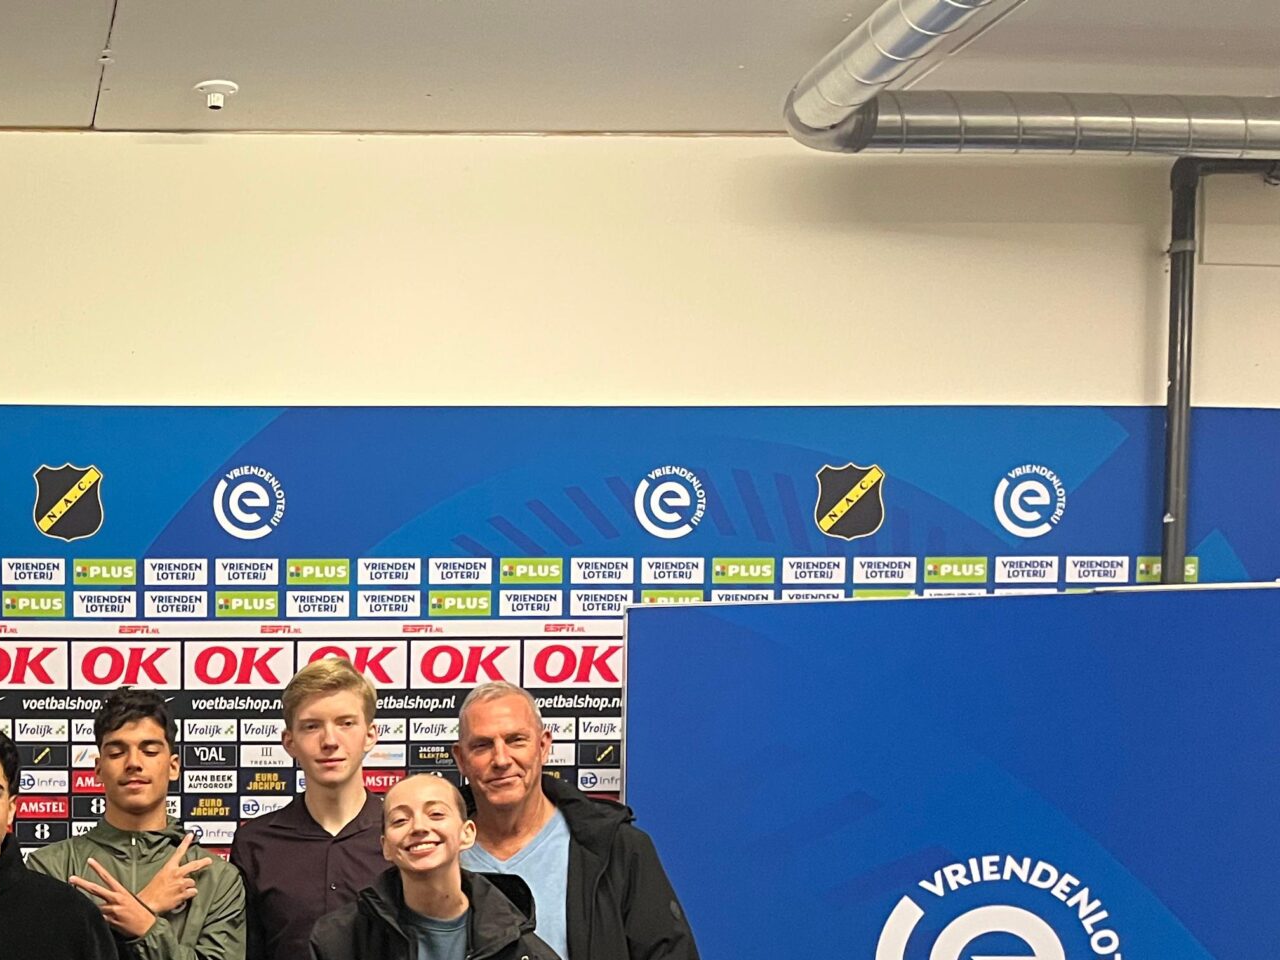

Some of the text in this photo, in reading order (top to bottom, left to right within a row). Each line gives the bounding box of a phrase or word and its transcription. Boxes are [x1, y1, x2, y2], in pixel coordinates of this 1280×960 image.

[225, 465, 286, 527] VRIENDENLOTERIJ
[647, 465, 707, 526] VRIENDENLOTERIJ
[1007, 464, 1066, 525] VRIENDENLOTERIJ
[7, 562, 60, 571] VRIENDEN
[88, 565, 134, 578] PLUS
[221, 562, 273, 571] VRIENDEN
[301, 565, 347, 578] PLUS
[514, 564, 562, 577] PLUS
[576, 561, 629, 570] VRIENDEN
[728, 564, 773, 577] PLUS
[859, 561, 911, 570] VRIENDEN
[939, 563, 984, 576] PLUS
[14, 571, 53, 581] LOTERIJ
[227, 571, 267, 581] LOTERIJ
[582, 570, 622, 580] LOTERIJ
[865, 570, 904, 580] LOTERIJ
[230, 598, 276, 611] PLUS
[363, 594, 415, 603] VRIENDEN
[369, 603, 408, 613] LOTERIJ
[81, 646, 171, 685] OK
[194, 646, 284, 685] OK
[420, 645, 510, 684] OK
[533, 644, 624, 684] OK
[375, 695, 456, 711] etbalshop.nl
[18, 724, 53, 738] Vrolijk
[187, 724, 222, 738] Vrolijk
[188, 774, 233, 782] VAN BEEK
[20, 801, 65, 813] AMSTEL
[199, 798, 222, 808] EURO
